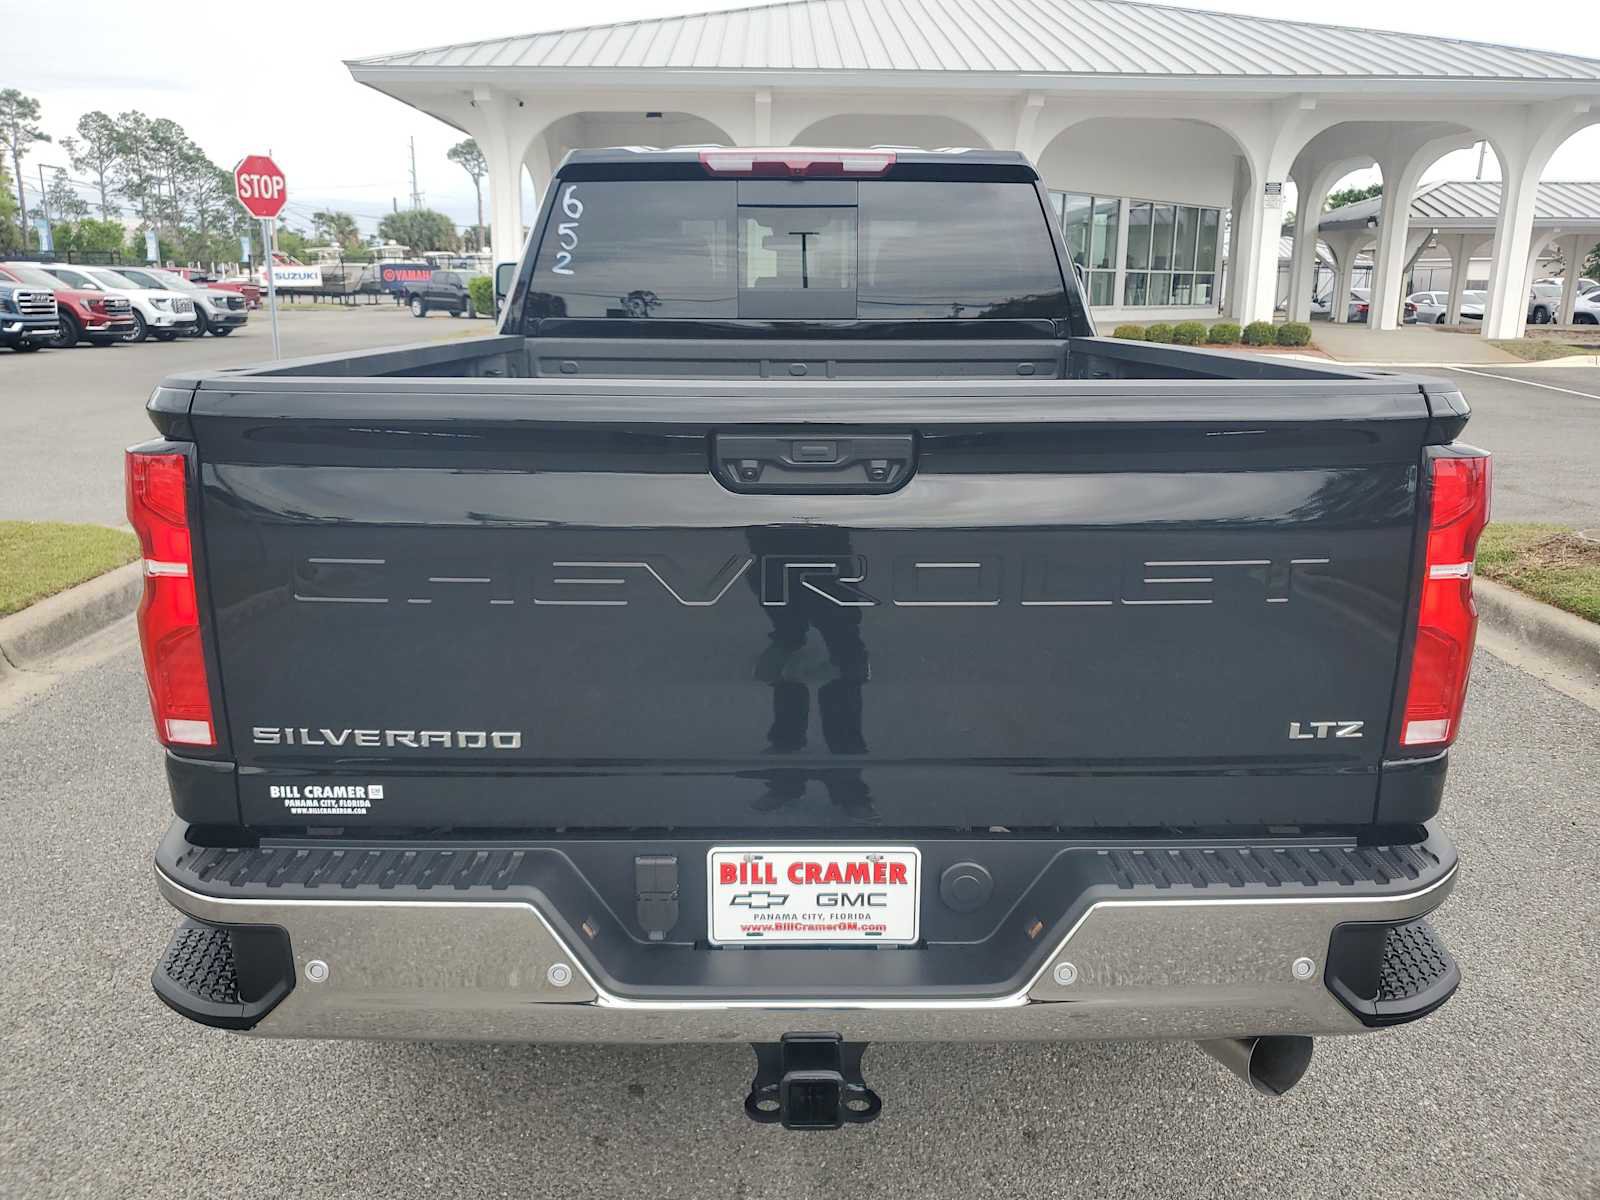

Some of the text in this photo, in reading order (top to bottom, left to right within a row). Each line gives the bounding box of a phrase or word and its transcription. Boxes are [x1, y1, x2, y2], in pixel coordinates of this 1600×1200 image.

[240, 173, 284, 199] STOP
[552, 185, 584, 275] 652
[275, 272, 318, 280] SUZUKI
[395, 269, 433, 281] YAMAH
[294, 554, 1331, 606] CHEVROLET
[253, 727, 522, 749] SILVERADO
[1289, 721, 1364, 739] LTZ
[270, 786, 301, 798] BILL
[304, 786, 366, 798] CRAMER
[285, 799, 371, 808] PANAMA CITY, FLORIDA
[719, 862, 908, 885] BILL CRAMER
[816, 893, 887, 907] GMC
[753, 913, 872, 922] PANAMA CITY, FLORIDA
